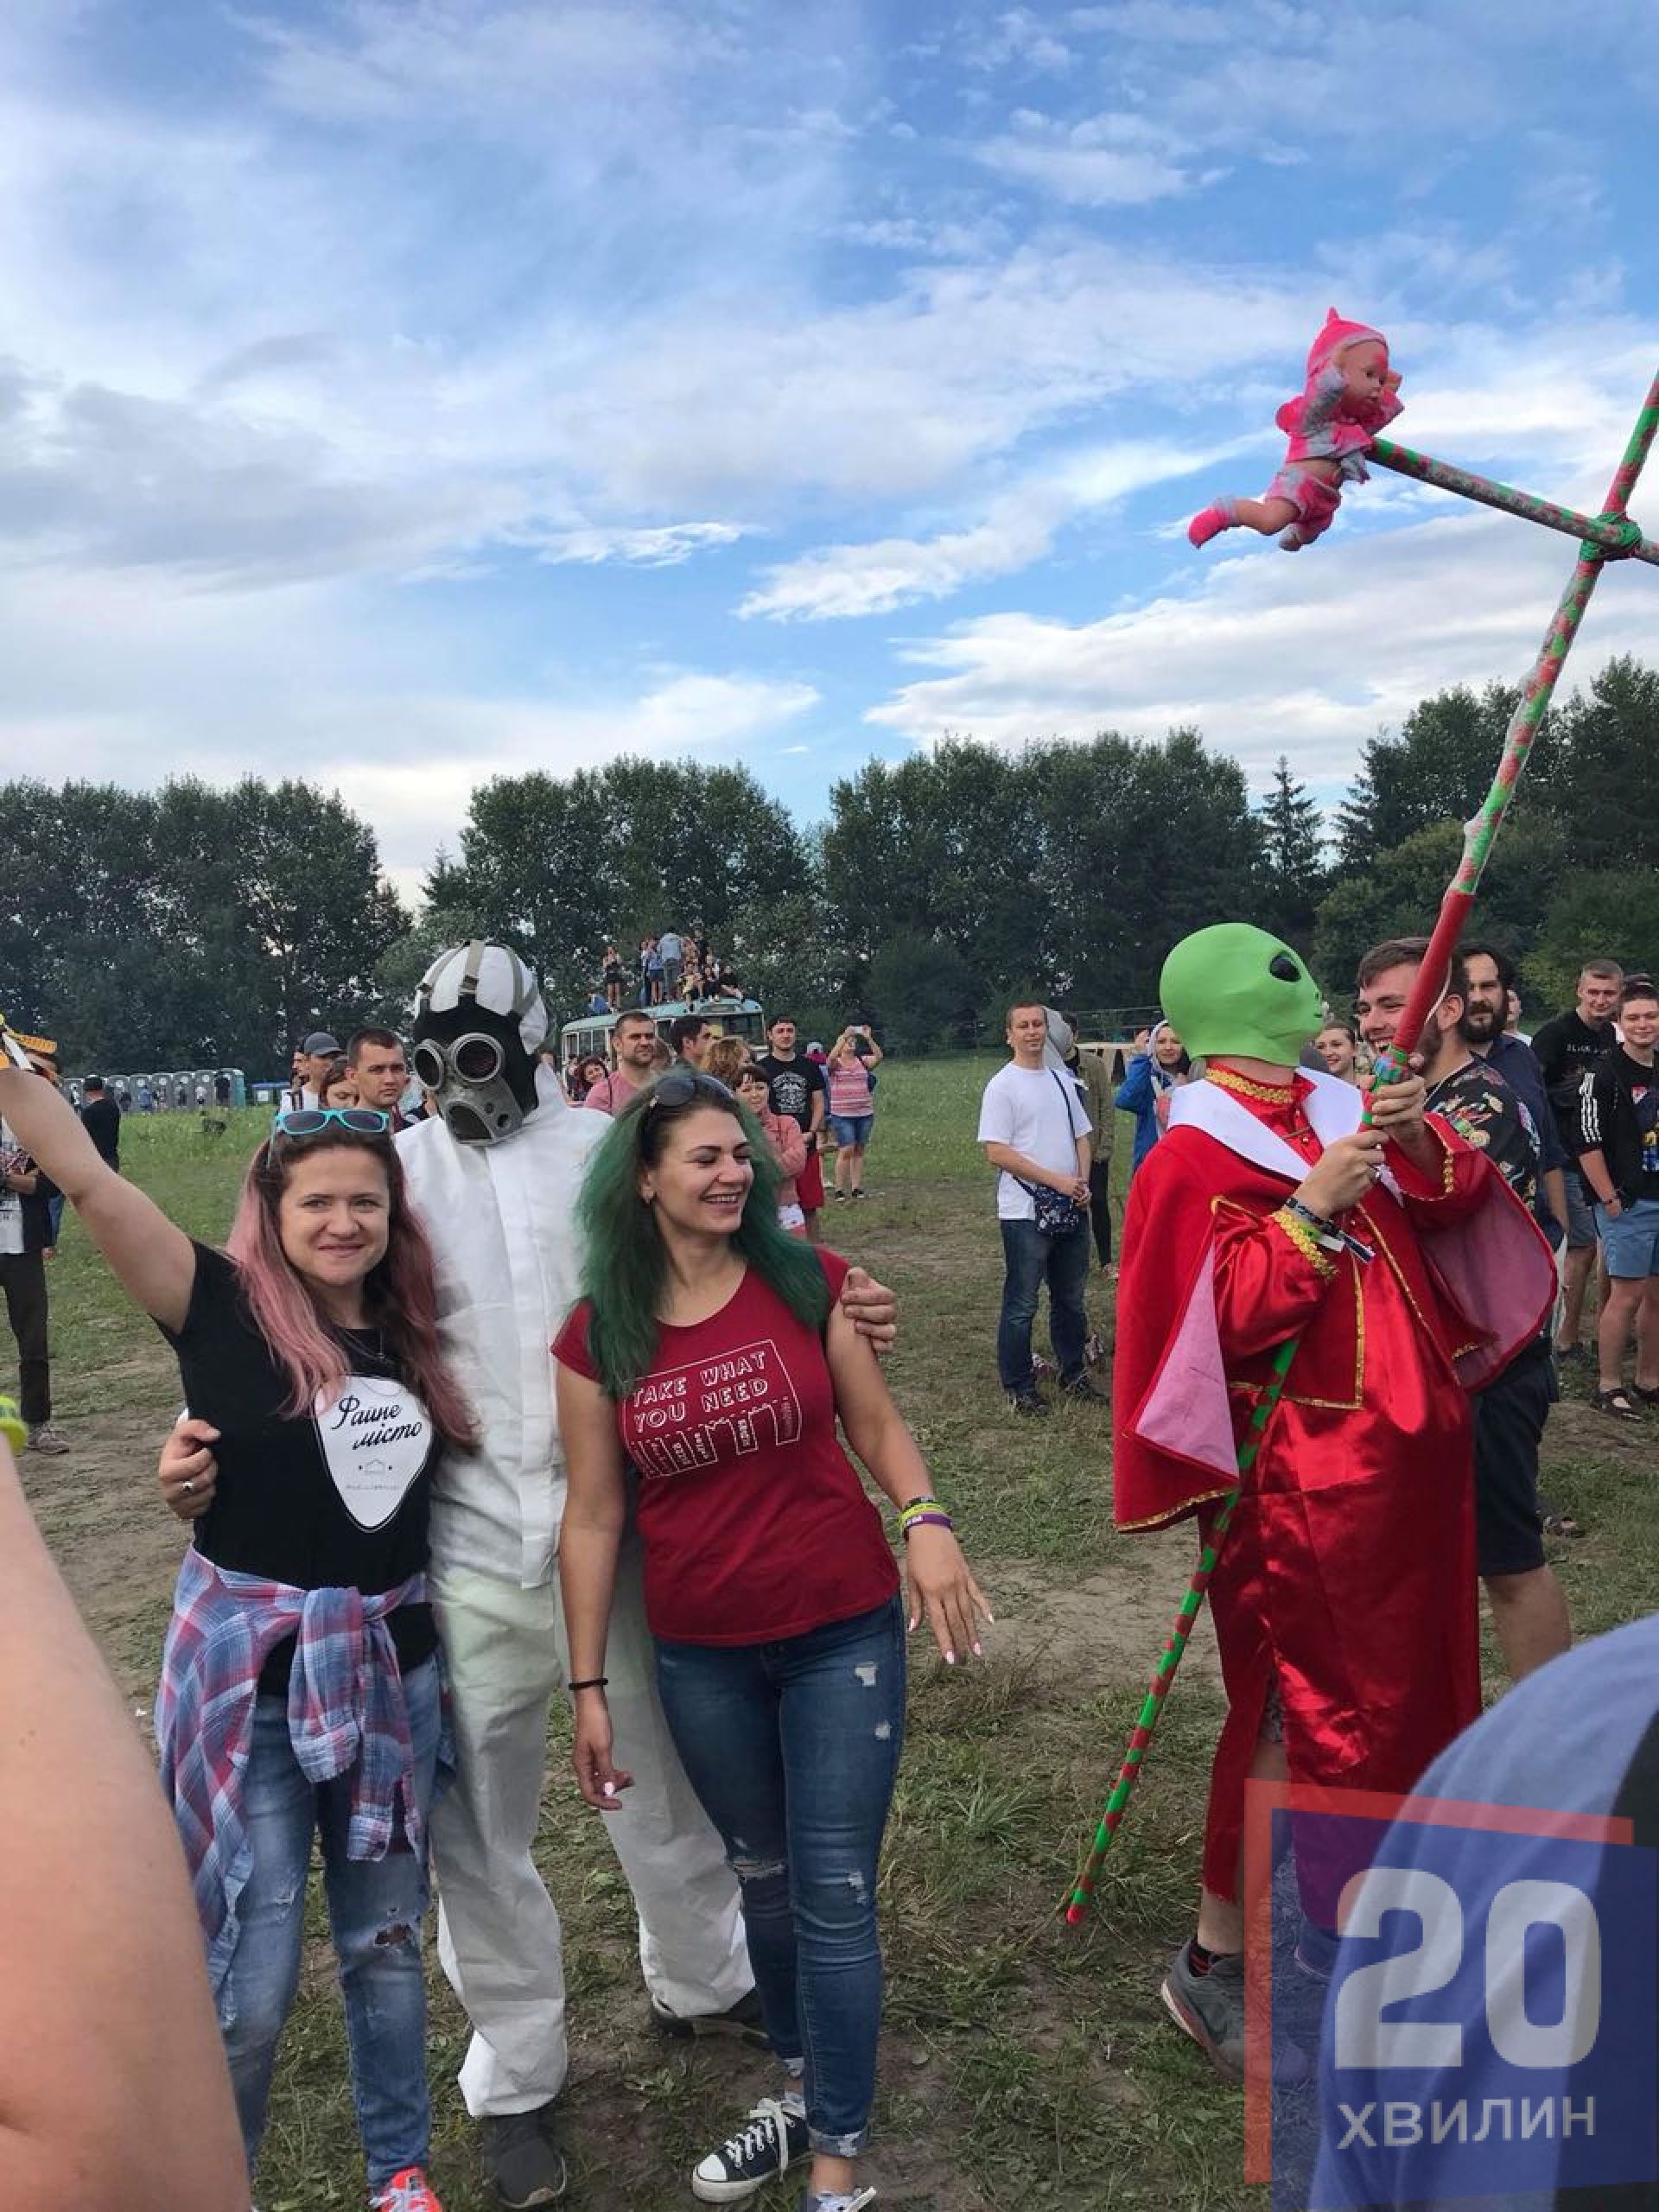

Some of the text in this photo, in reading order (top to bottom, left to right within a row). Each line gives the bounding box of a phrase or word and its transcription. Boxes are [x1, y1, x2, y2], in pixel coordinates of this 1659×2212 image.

[633, 1351, 766, 1408] TAKE WHAT
[633, 1377, 768, 1433] YOU NEED
[352, 1421, 423, 1451] місто
